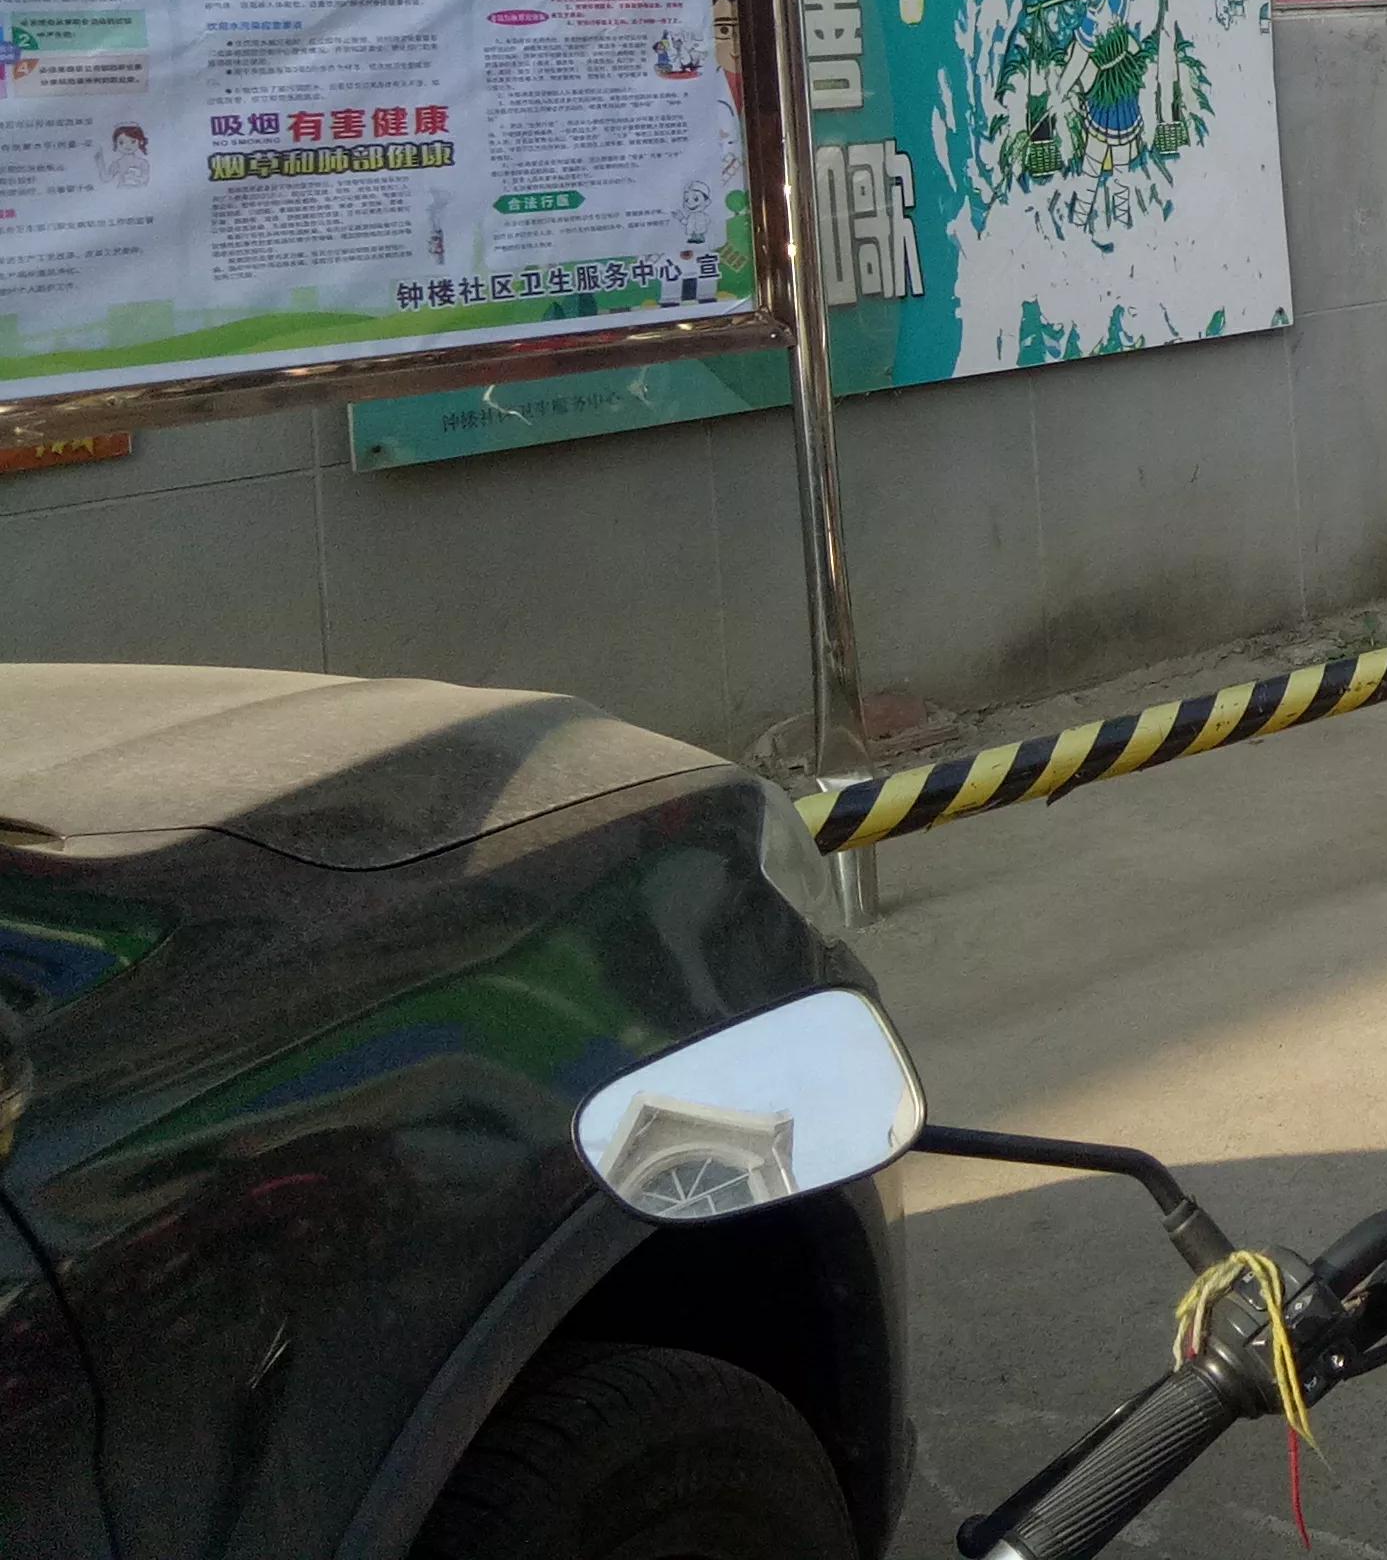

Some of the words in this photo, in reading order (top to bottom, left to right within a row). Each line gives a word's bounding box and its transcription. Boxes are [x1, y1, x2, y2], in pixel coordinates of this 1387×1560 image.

[18, 33, 31, 48] 2
[17, 61, 30, 76] 4
[210, 112, 281, 138] 吸烟
[287, 104, 450, 144] 有害健康
[212, 139, 229, 147] NO
[231, 137, 281, 146] SMOKING
[208, 140, 456, 182] 烟草和肺部健康
[507, 192, 571, 211] 合法行医
[396, 259, 683, 310] 钟楼社区卫生服务中心
[696, 253, 721, 280] 宣
